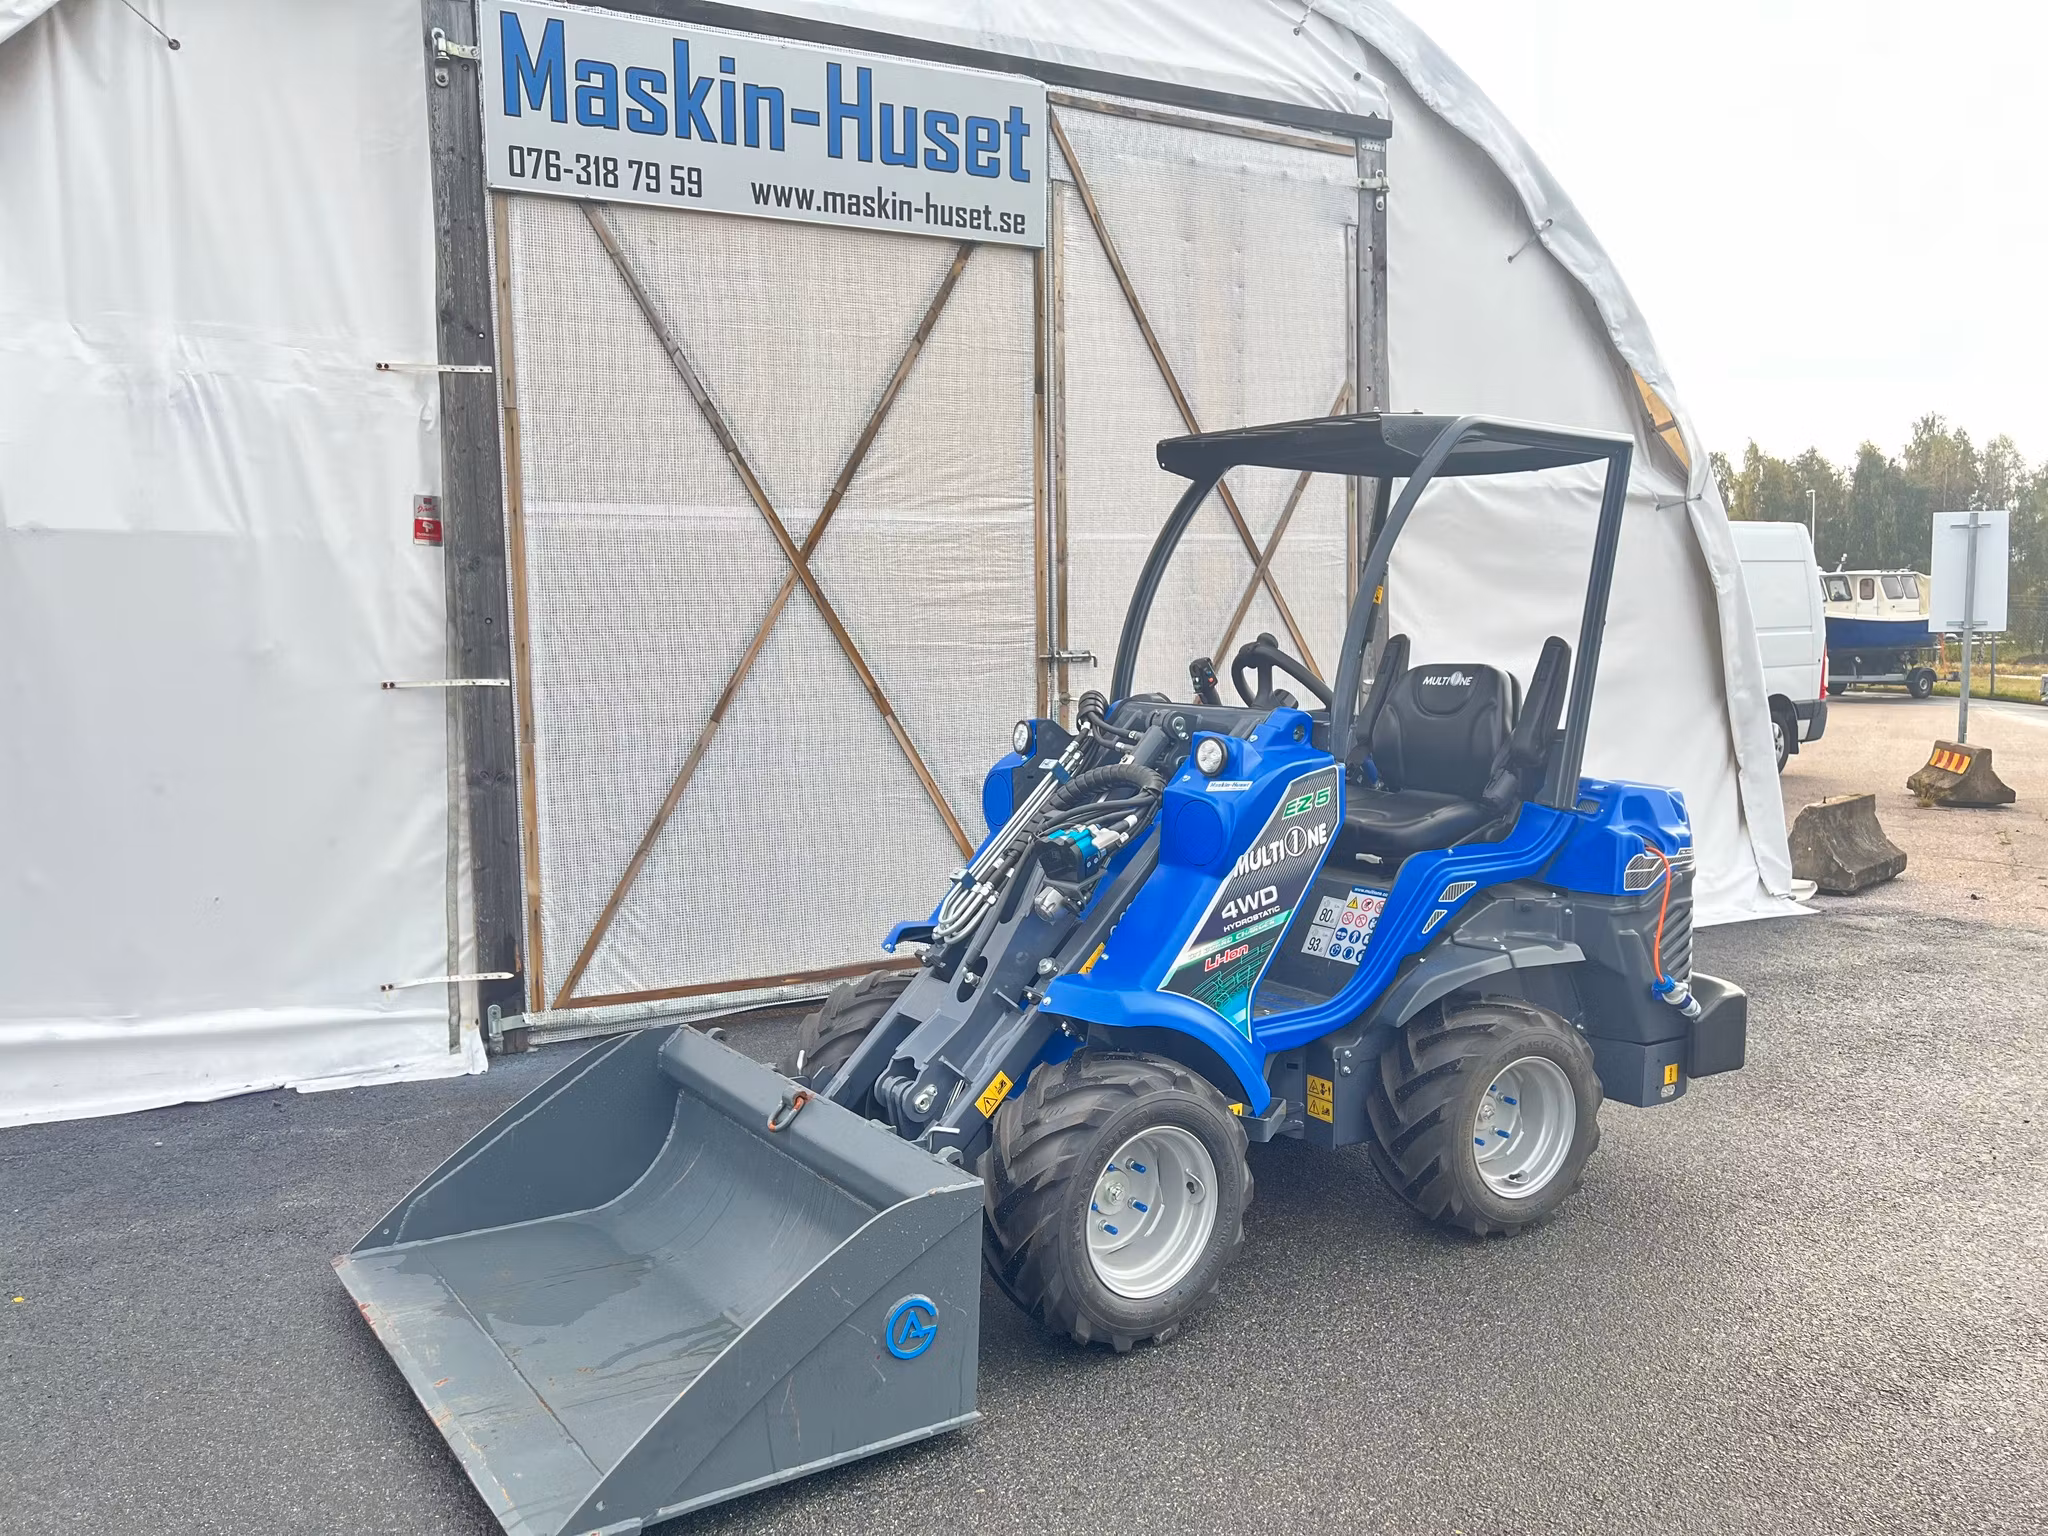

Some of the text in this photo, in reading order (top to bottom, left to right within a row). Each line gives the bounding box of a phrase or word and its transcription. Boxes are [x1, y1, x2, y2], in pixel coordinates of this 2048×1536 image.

[500, 10, 1031, 183] Maskin-Huset
[508, 145, 702, 198] 076-318 79 59
[751, 181, 1026, 235] www.maskin-huset.se
[1221, 885, 1278, 919] 4WD
[1319, 907, 1333, 923] 80
[1223, 905, 1281, 933] HYDROSTATIC
[1204, 944, 1249, 972] Li-Ion
[1307, 936, 1321, 952] 93
